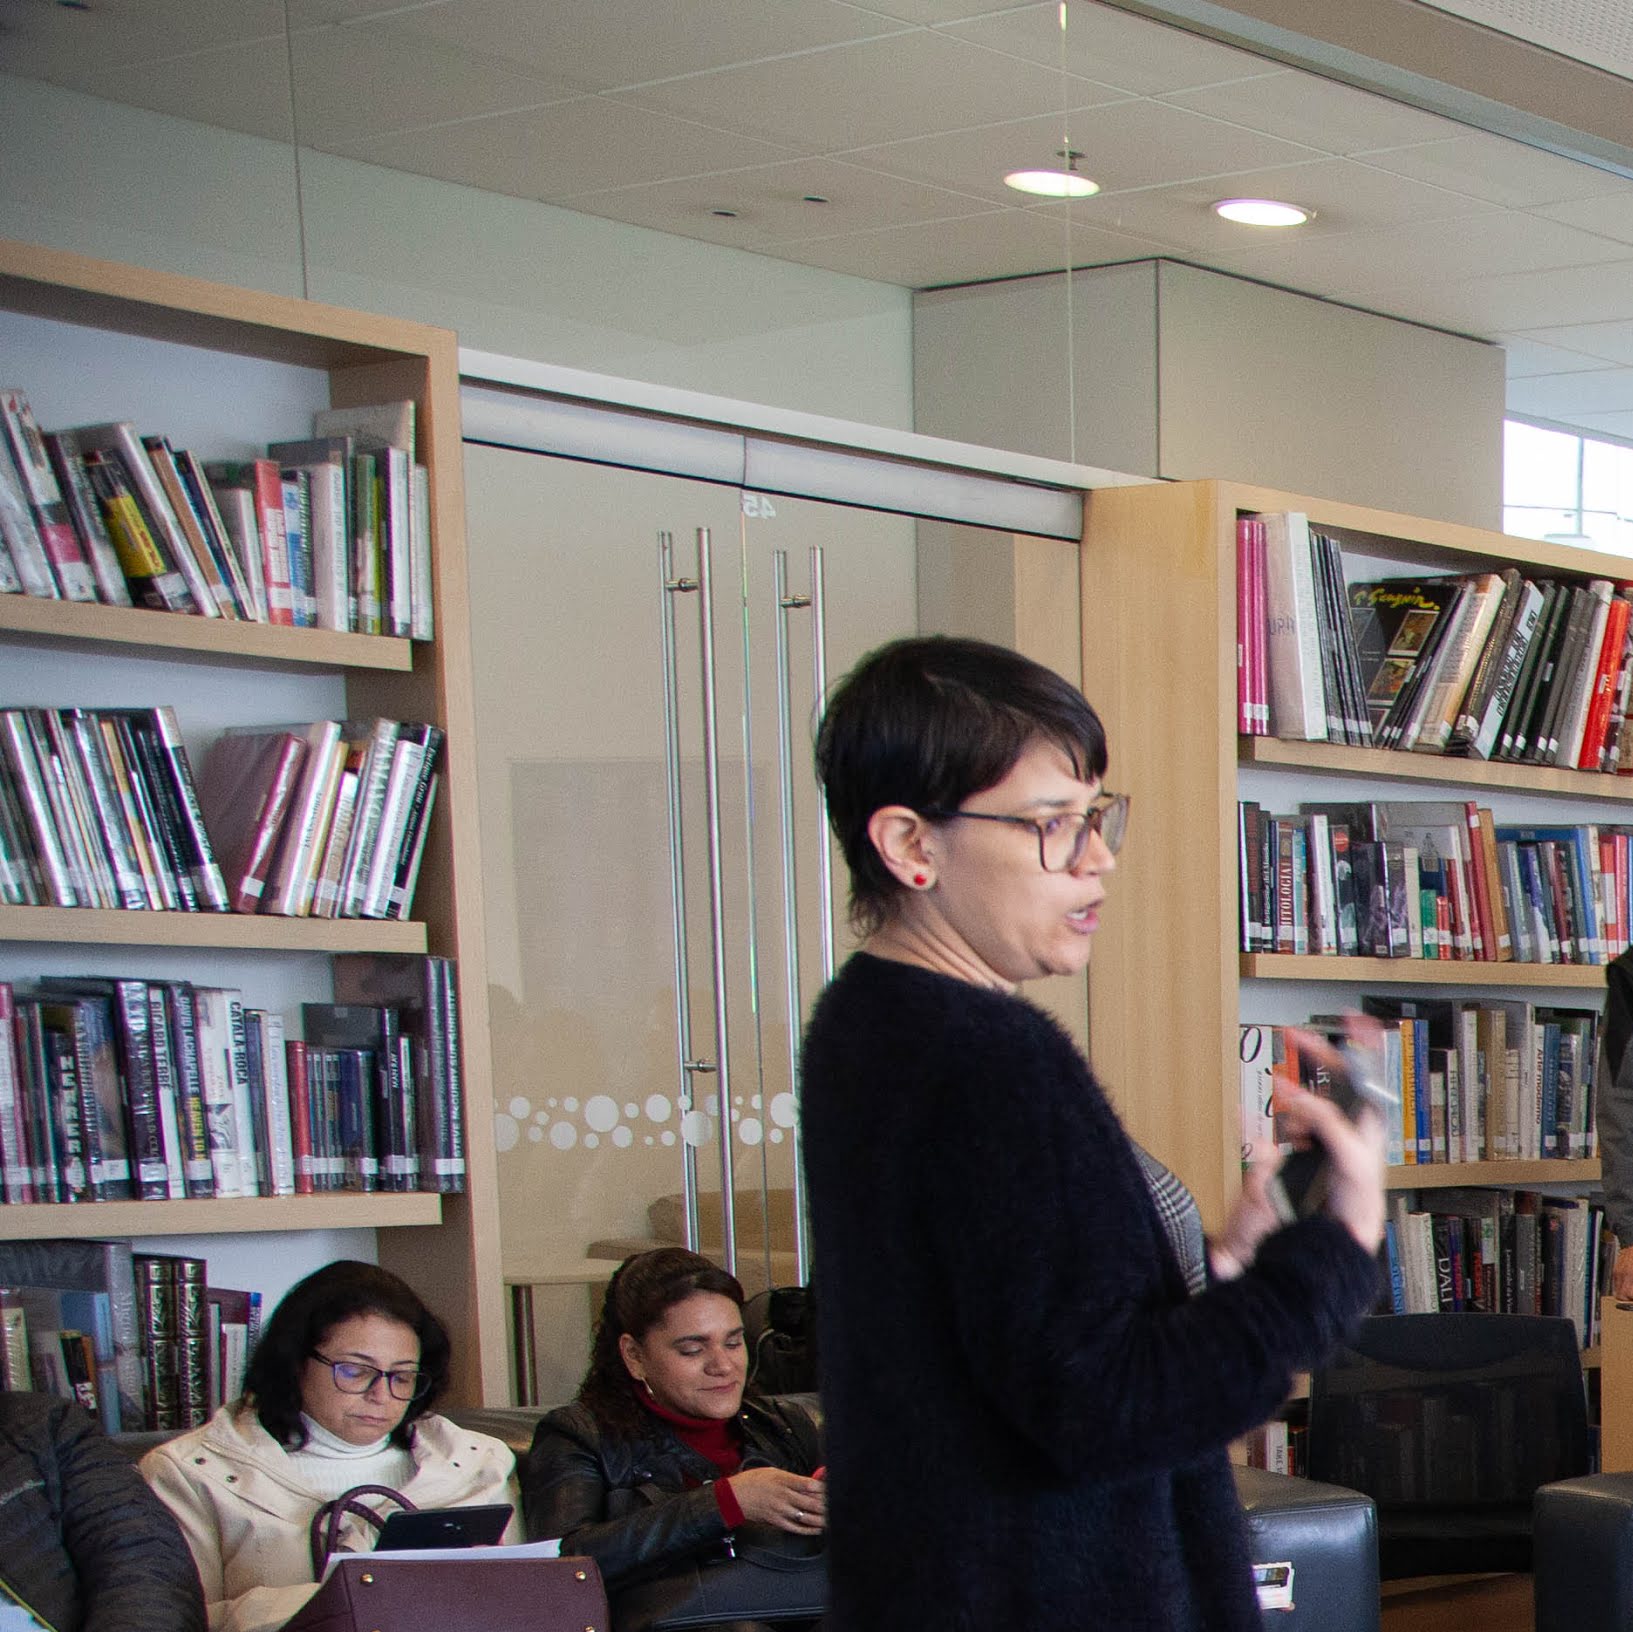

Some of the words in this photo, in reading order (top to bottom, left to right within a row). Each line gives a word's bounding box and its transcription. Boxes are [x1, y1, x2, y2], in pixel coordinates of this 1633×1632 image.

[180, 996, 190, 1027] DAVID
[183, 1029, 199, 1094] LACHAPELLE
[1536, 1048, 1544, 1072] Arte
